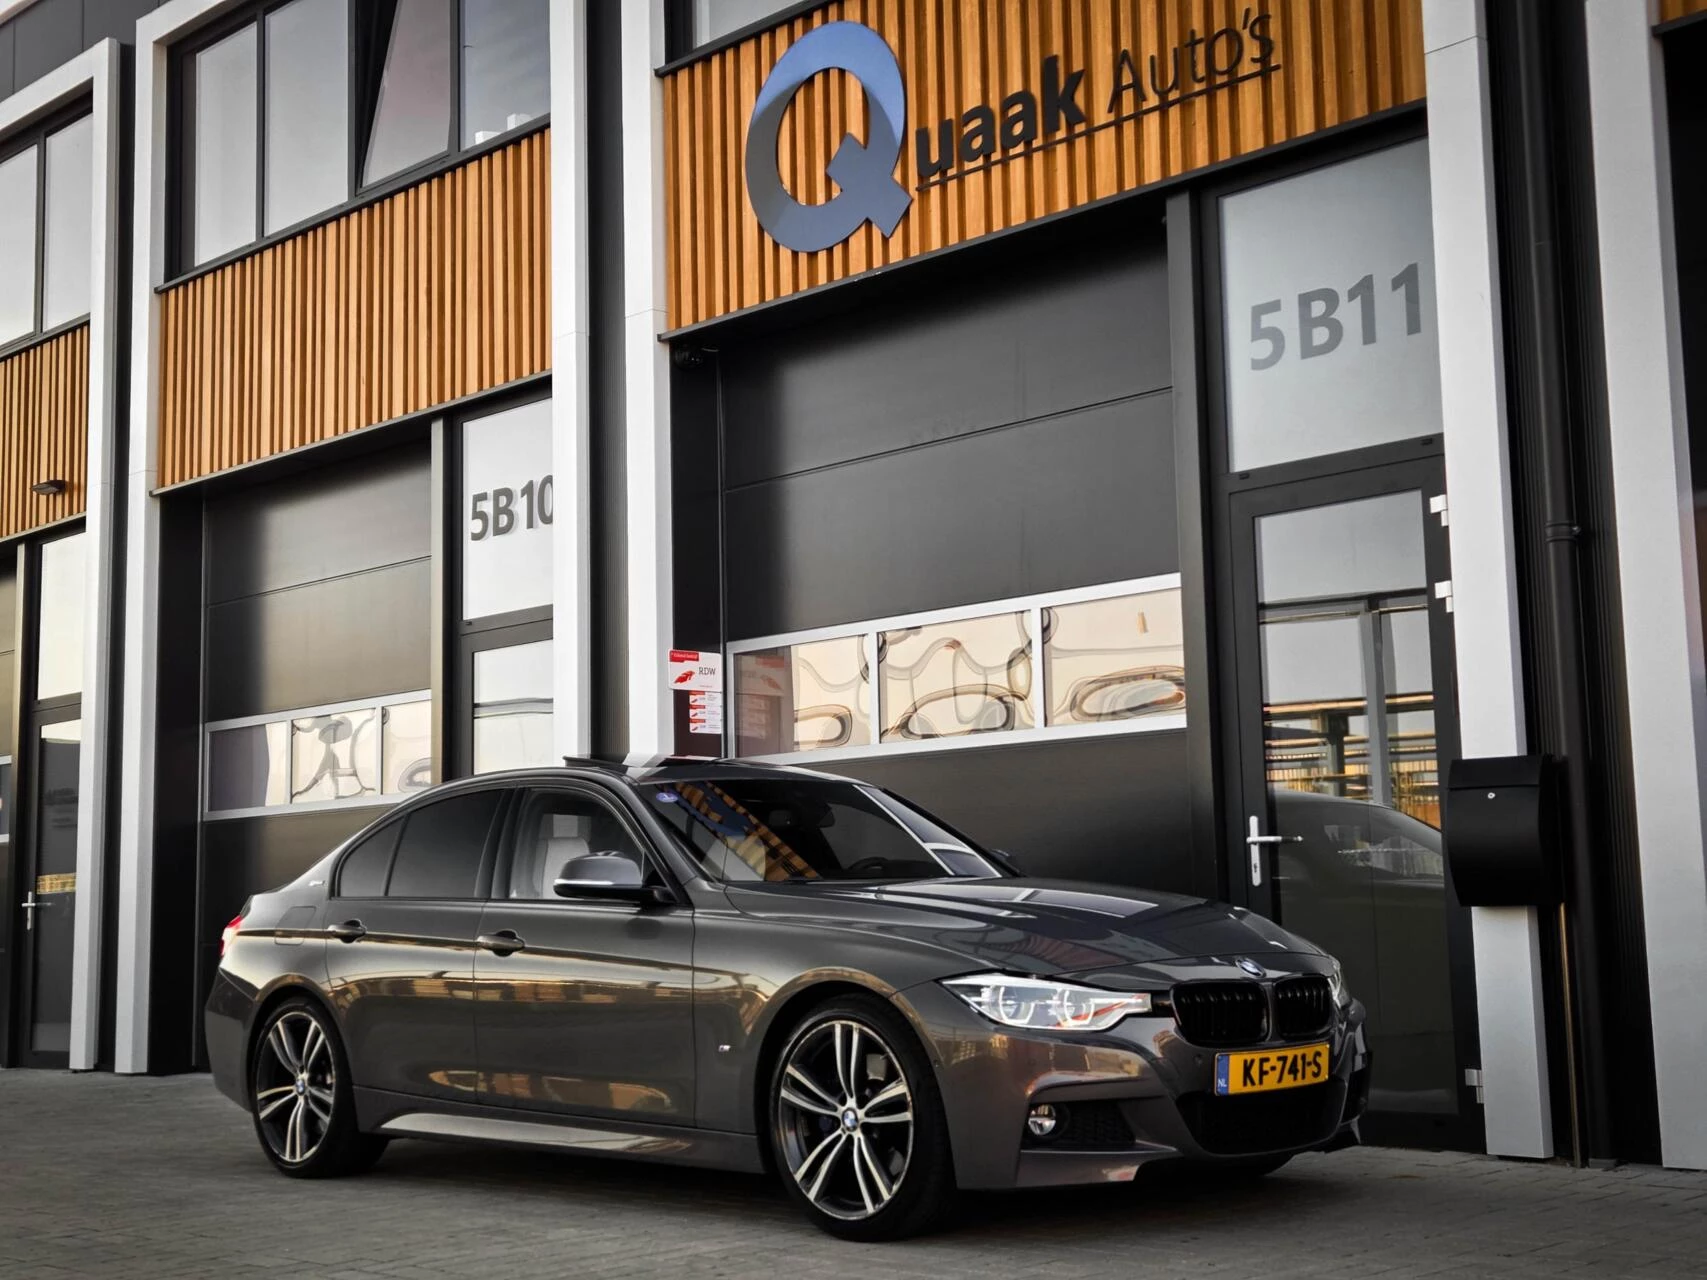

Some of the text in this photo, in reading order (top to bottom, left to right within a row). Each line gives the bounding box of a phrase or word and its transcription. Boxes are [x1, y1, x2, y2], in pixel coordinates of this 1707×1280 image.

[745, 7, 1275, 253] Quaak Auto's
[470, 474, 553, 542] 5B10
[698, 666, 716, 676] RDW
[1217, 1078, 1227, 1088] NL
[1242, 1050, 1322, 1087] KF-741-S
